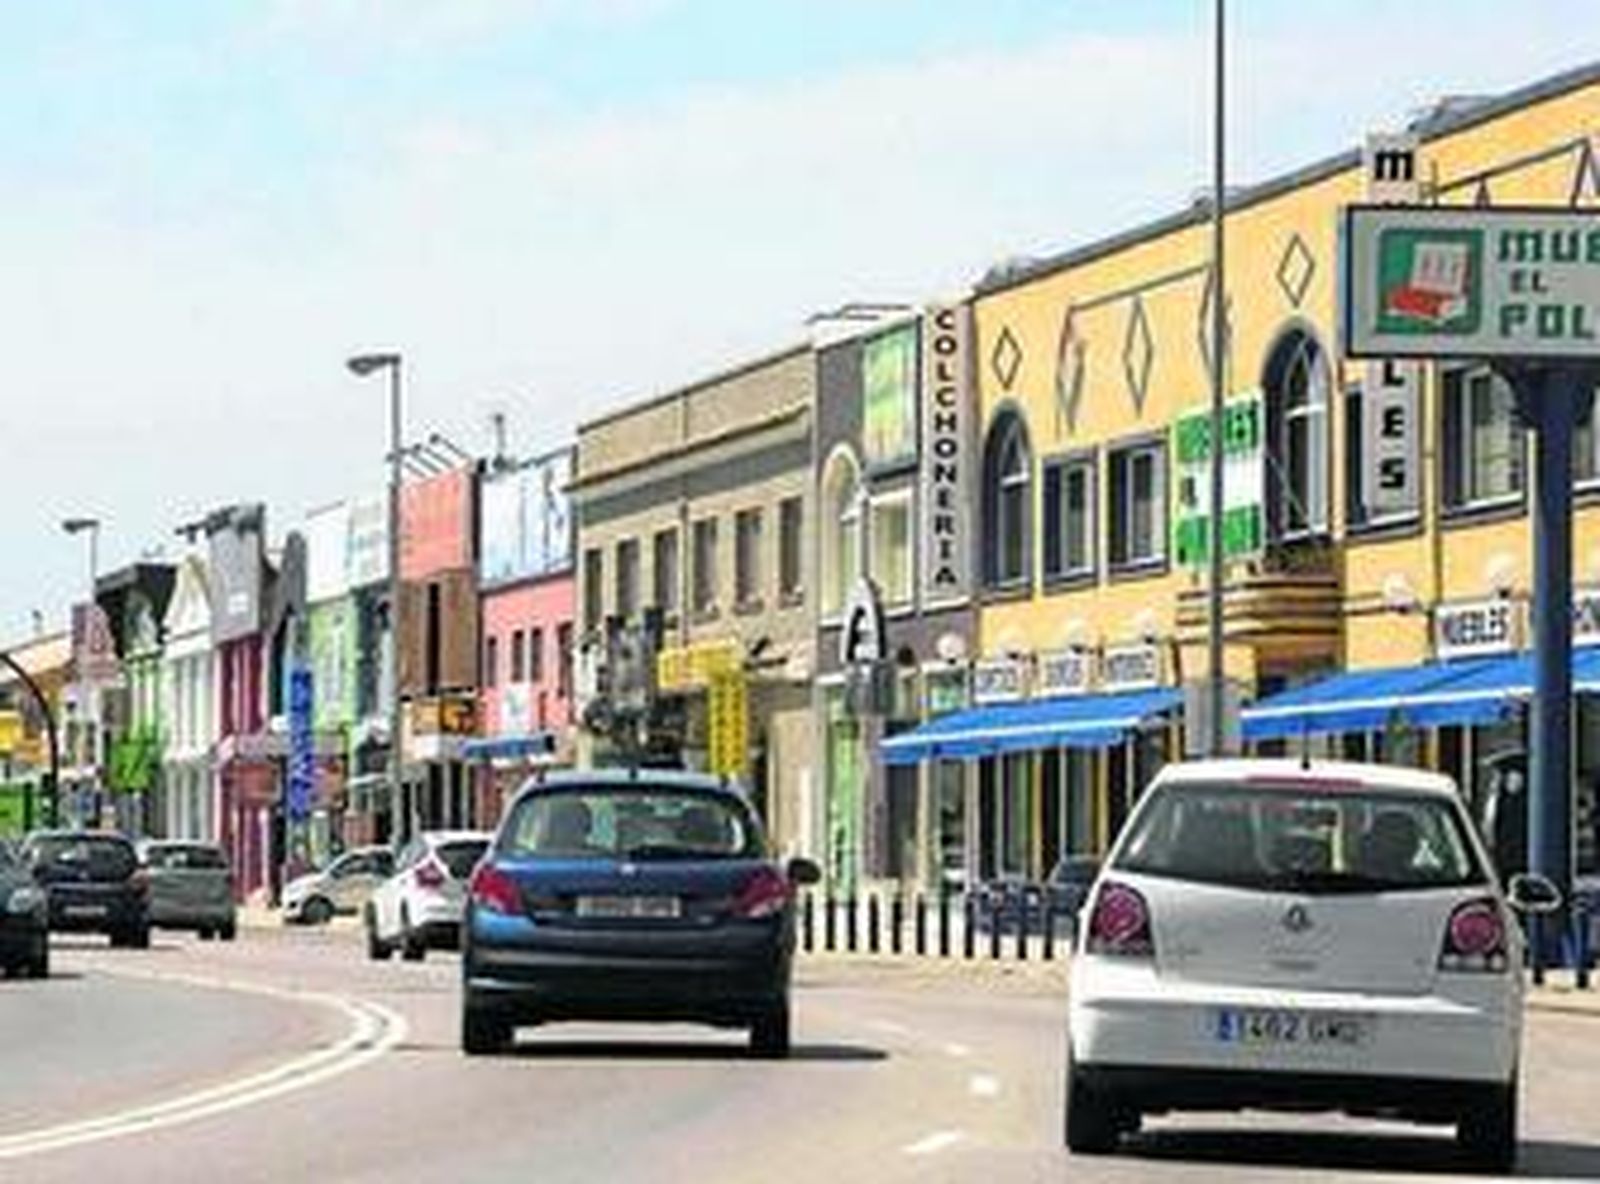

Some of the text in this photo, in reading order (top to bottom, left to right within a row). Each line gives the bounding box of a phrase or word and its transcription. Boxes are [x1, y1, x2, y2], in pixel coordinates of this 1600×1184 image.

[1509, 268, 1549, 294] EL
[1499, 304, 1596, 339] POL
[934, 309, 957, 586] COLCHONERIA
